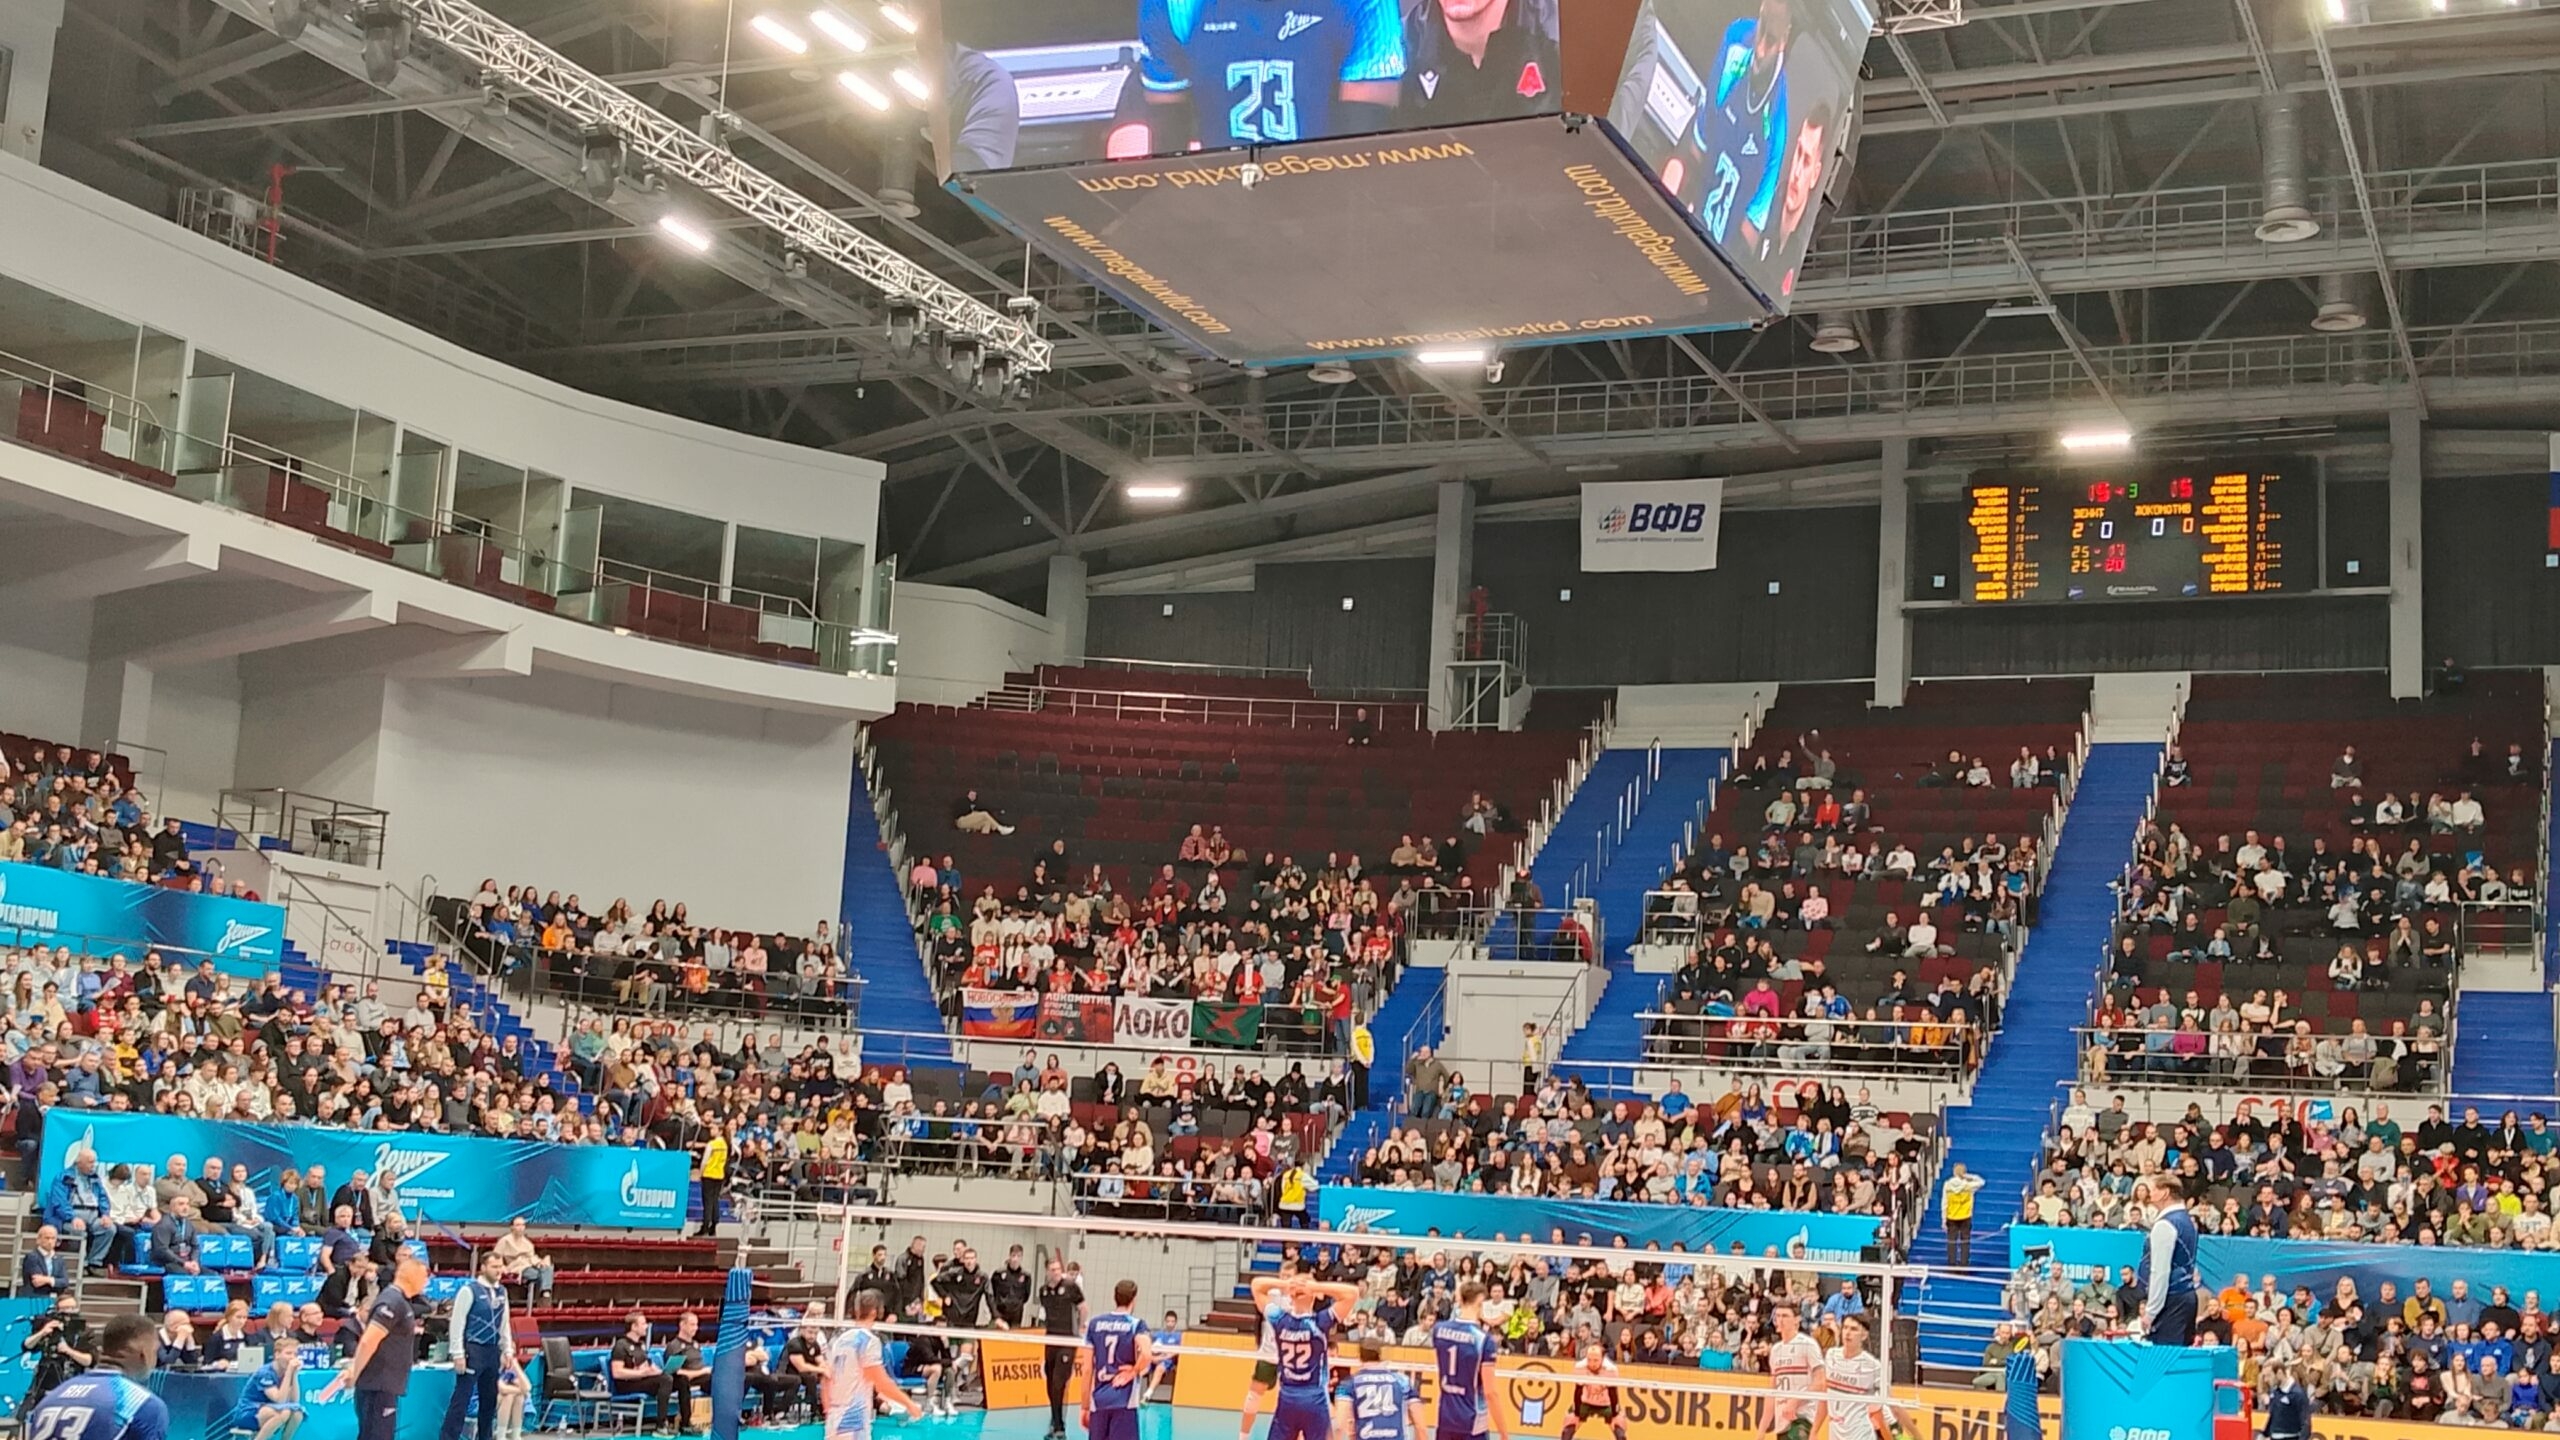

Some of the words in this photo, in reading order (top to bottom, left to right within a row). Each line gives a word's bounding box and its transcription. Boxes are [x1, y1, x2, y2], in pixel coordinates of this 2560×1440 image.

[1227, 60, 1297, 141] 23
[1628, 503, 1706, 533] ВФВ
[2072, 522, 2084, 538] 2
[2100, 521, 2113, 539] 0
[2151, 517, 2165, 536] 0
[2182, 517, 2194, 533] 0
[2071, 545, 2090, 558] 25
[2071, 559, 2090, 573] 25
[1115, 1003, 1190, 1039] ЛОКО
[1105, 1334, 1119, 1364] 7
[1281, 1342, 1311, 1369] 22
[1448, 1344, 1457, 1376] 1
[1355, 1384, 1399, 1419] 24
